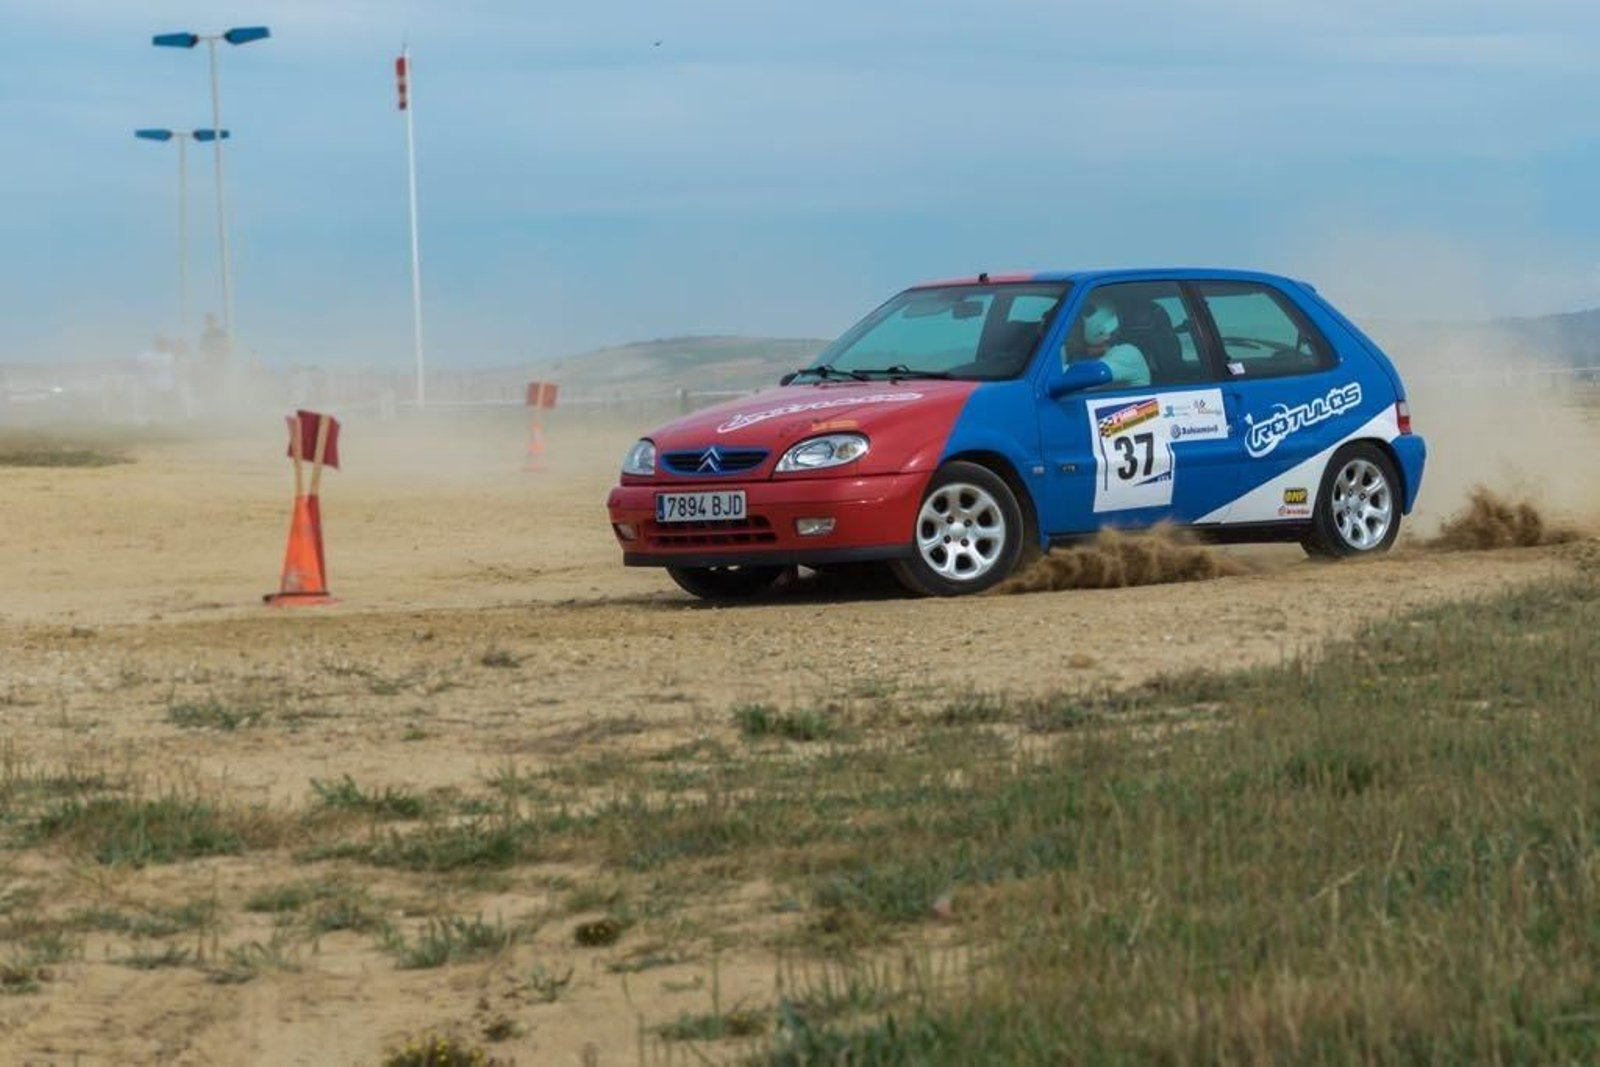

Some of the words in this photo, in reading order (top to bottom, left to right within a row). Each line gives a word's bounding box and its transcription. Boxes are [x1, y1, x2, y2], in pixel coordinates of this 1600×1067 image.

[1114, 431, 1154, 480] 37
[667, 495, 706, 518] 7894
[711, 494, 743, 516] BJD
